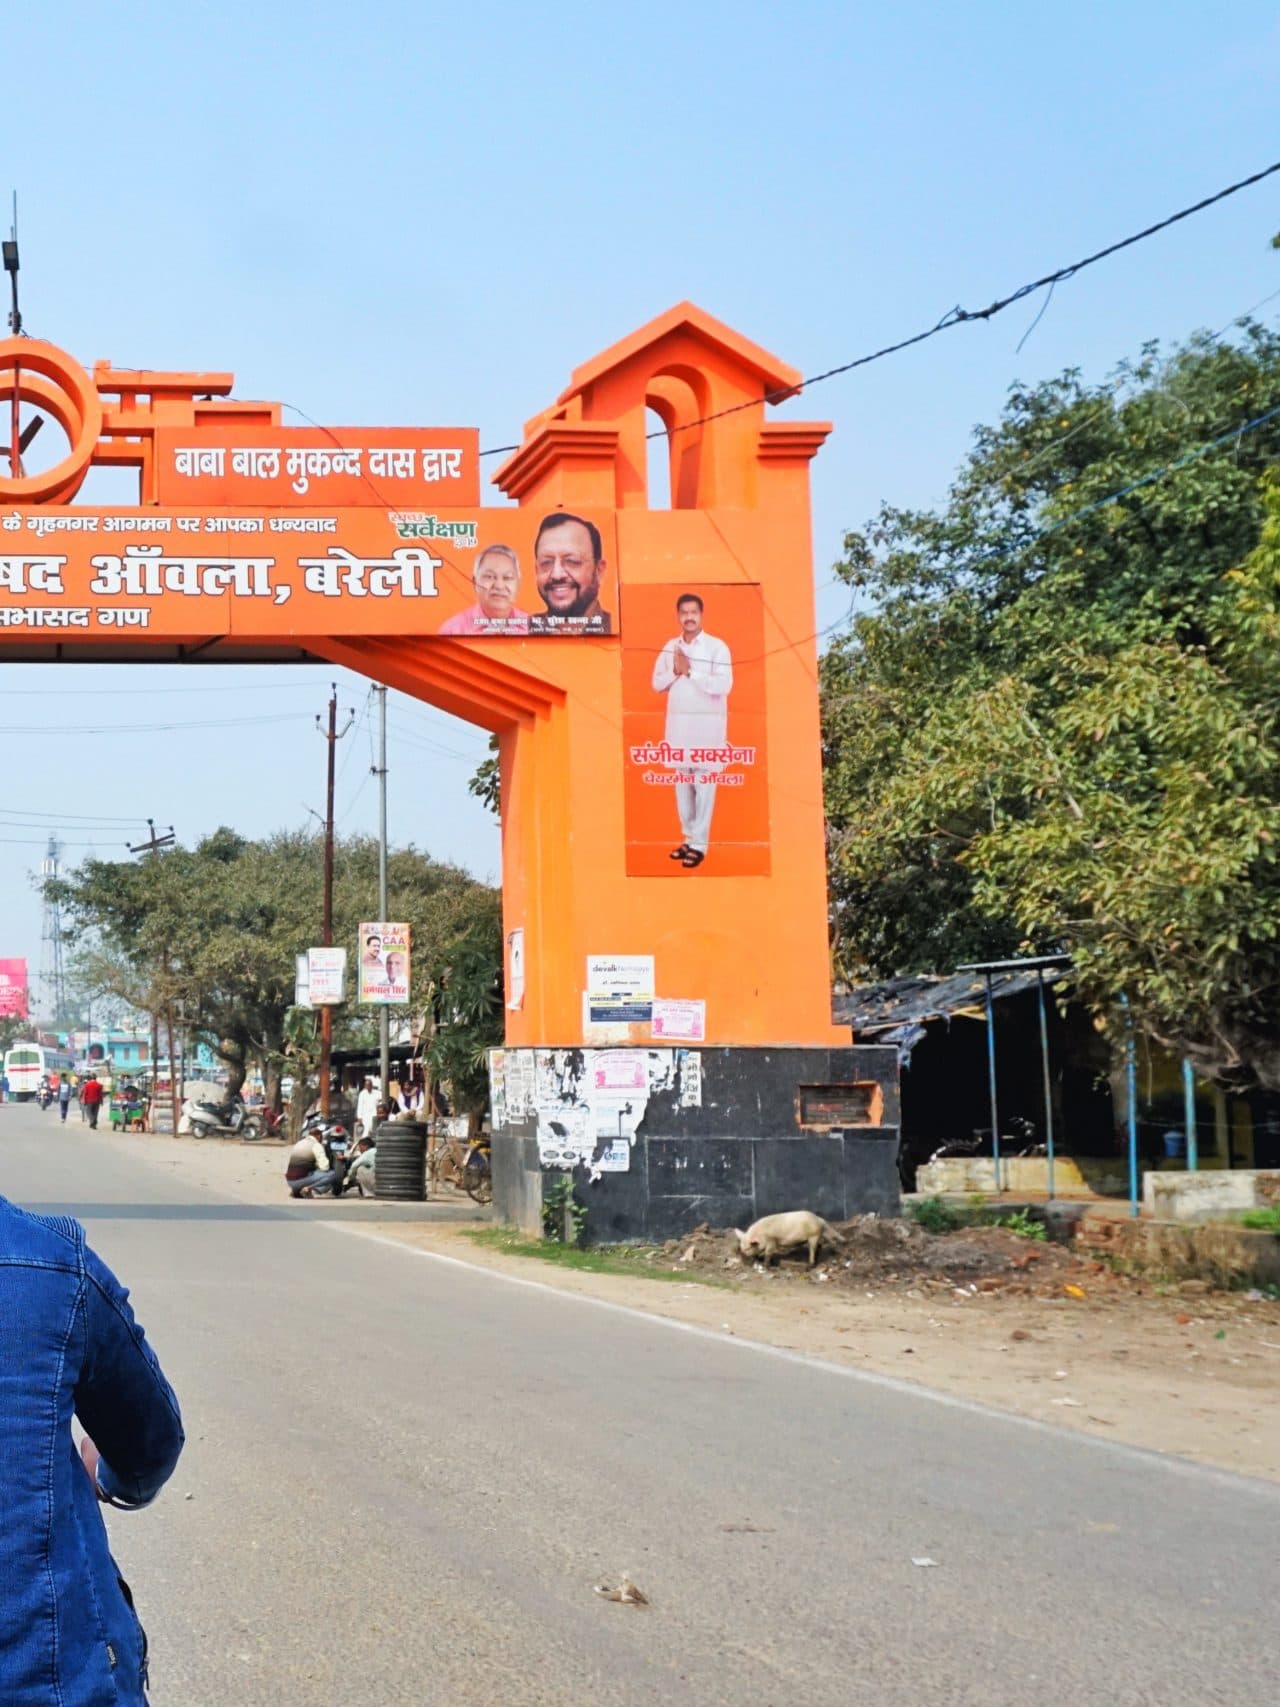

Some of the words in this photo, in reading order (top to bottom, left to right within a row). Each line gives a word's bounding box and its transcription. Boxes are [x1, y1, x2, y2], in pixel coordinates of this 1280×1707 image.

[174, 447, 226, 478] बाबा
[231, 447, 282, 479] बाल
[284, 447, 363, 494] मुकन्द
[367, 447, 417, 478] दास
[421, 447, 464, 482] द्वार
[1, 512, 22, 531] के
[26, 516, 100, 537] गृहनगर
[102, 516, 173, 533] आगमन
[176, 517, 200, 532] पर
[204, 517, 265, 533] आपका
[268, 517, 338, 533] धन्यवाद
[297, 546, 443, 597] बरेली
[96, 607, 152, 628] गण
[631, 741, 685, 763] संजीव
[689, 743, 754, 763] सक्सेना
